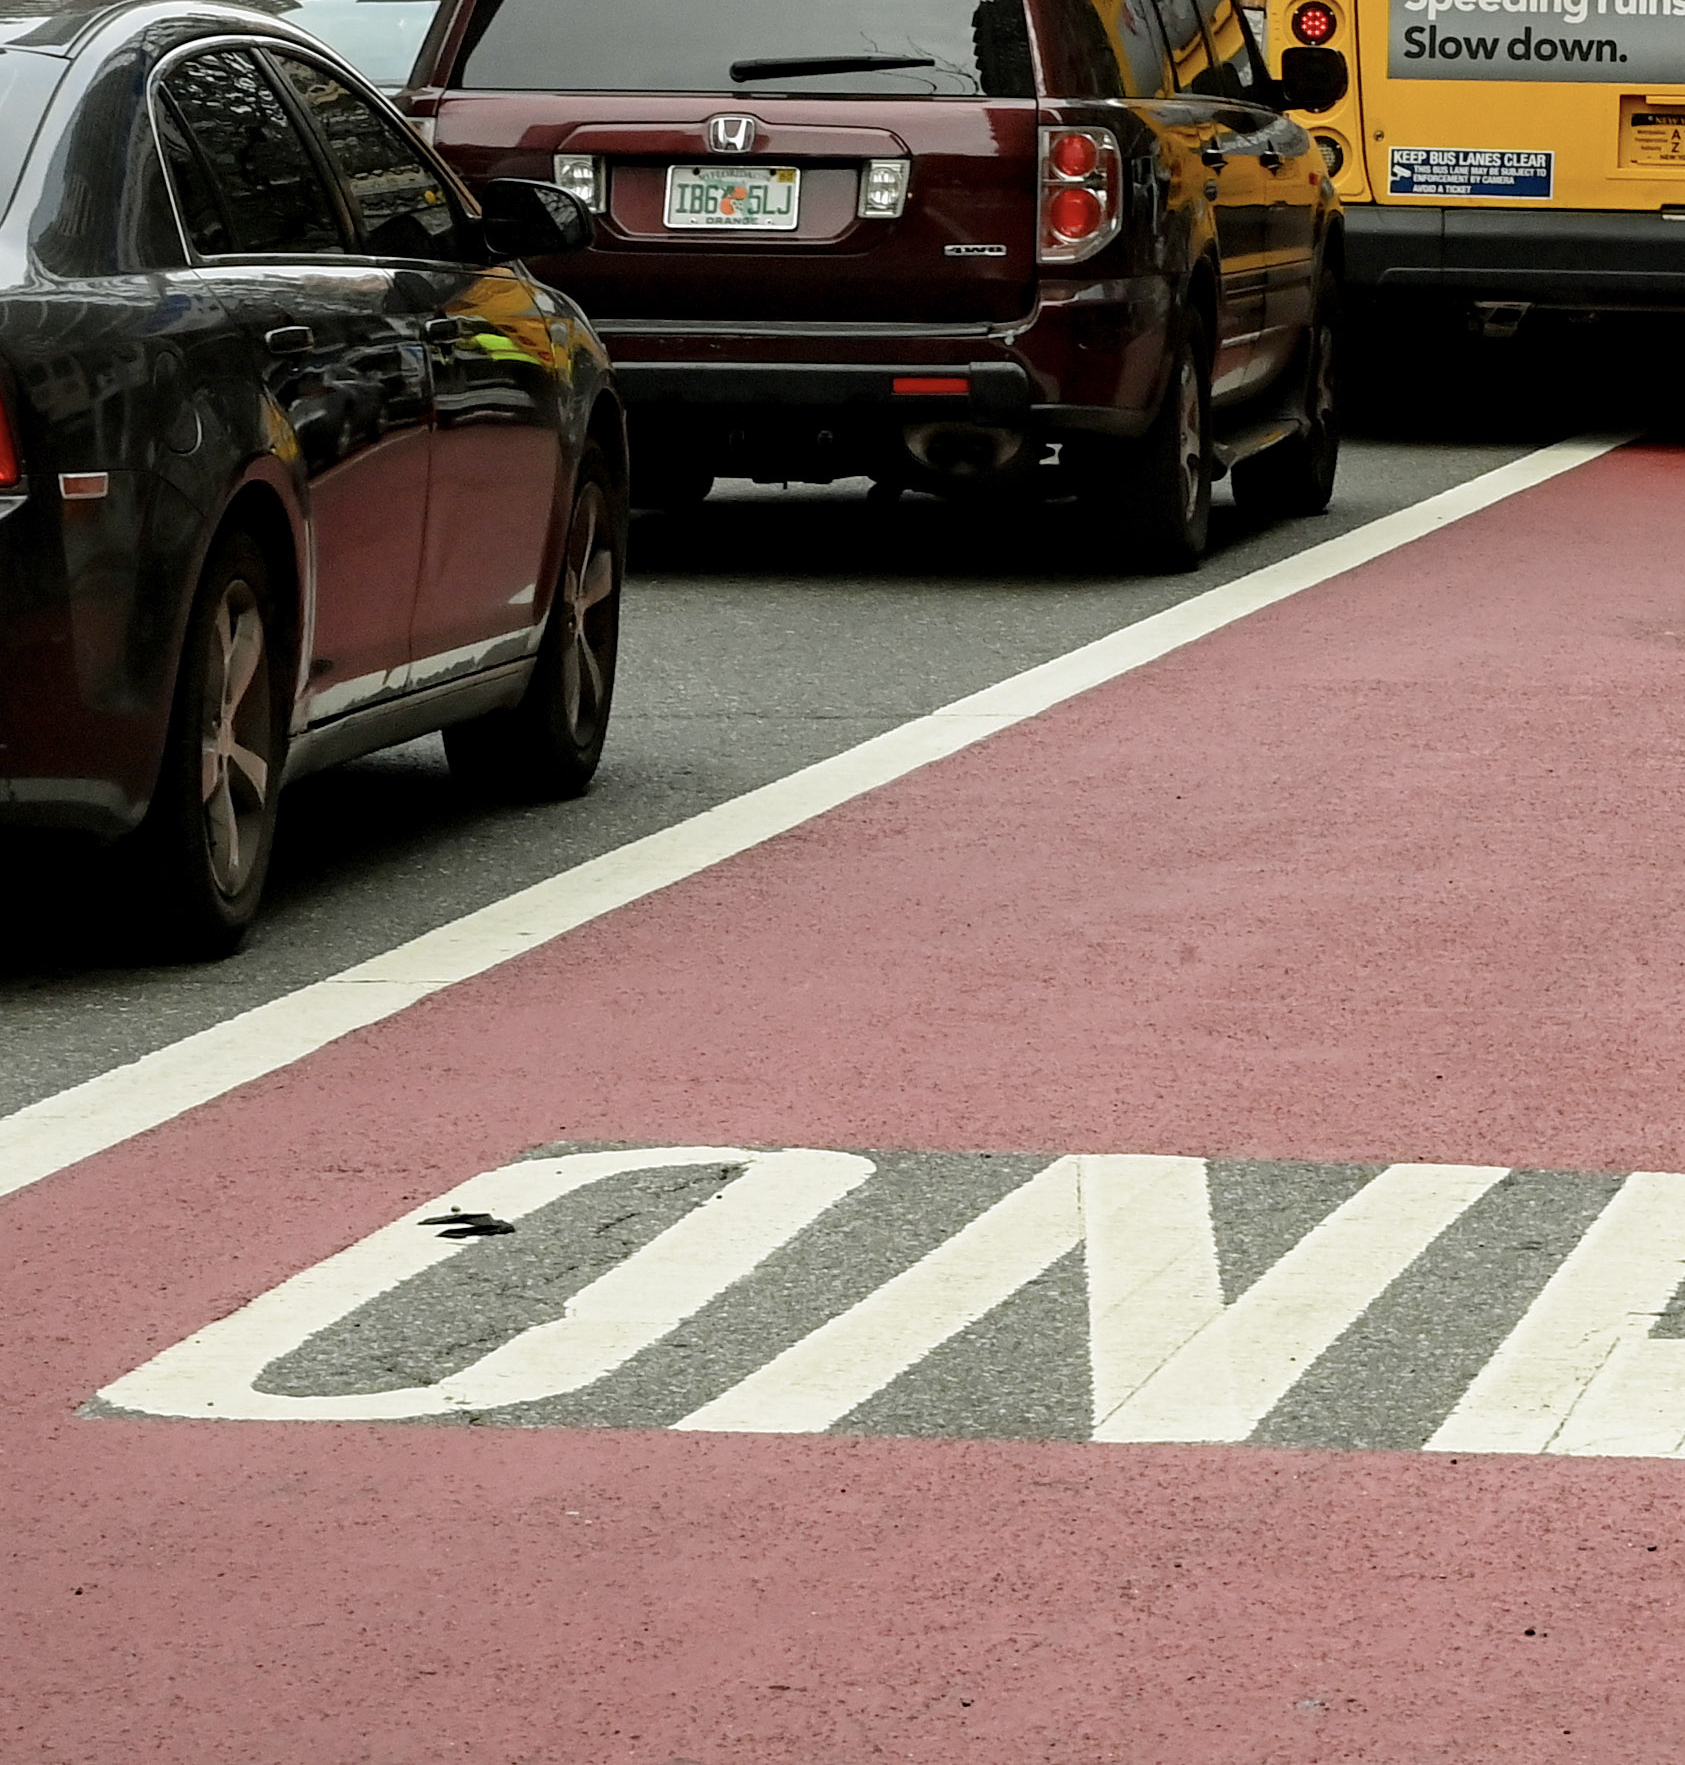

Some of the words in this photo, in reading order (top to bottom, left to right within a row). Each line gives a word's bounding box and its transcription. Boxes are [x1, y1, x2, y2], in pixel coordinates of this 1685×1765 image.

[1403, 25, 1498, 61] Slow
[1507, 26, 1628, 63] down.
[1393, 150, 1427, 165] KEEP
[1429, 151, 1456, 165] BUS
[1459, 152, 1501, 166] LANES
[1504, 153, 1546, 167] CLEAR
[1413, 165, 1431, 174] THIS
[1433, 166, 1449, 174] BUS
[1450, 166, 1470, 175] LANE
[1471, 166, 1488, 175] MAY
[1489, 167, 1500, 176] BE
[1501, 168, 1535, 177] SUBJECT
[1537, 169, 1546, 177] TO
[1413, 174, 1468, 184] ENFORCEMENT
[1470, 176, 1480, 184] BY
[1482, 176, 1515, 185] CAMERA
[1412, 185, 1436, 193] AVOID
[1446, 186, 1471, 194] TICKET
[747, 184, 792, 215] 5LJ
[705, 216, 759, 225] ORANGE
